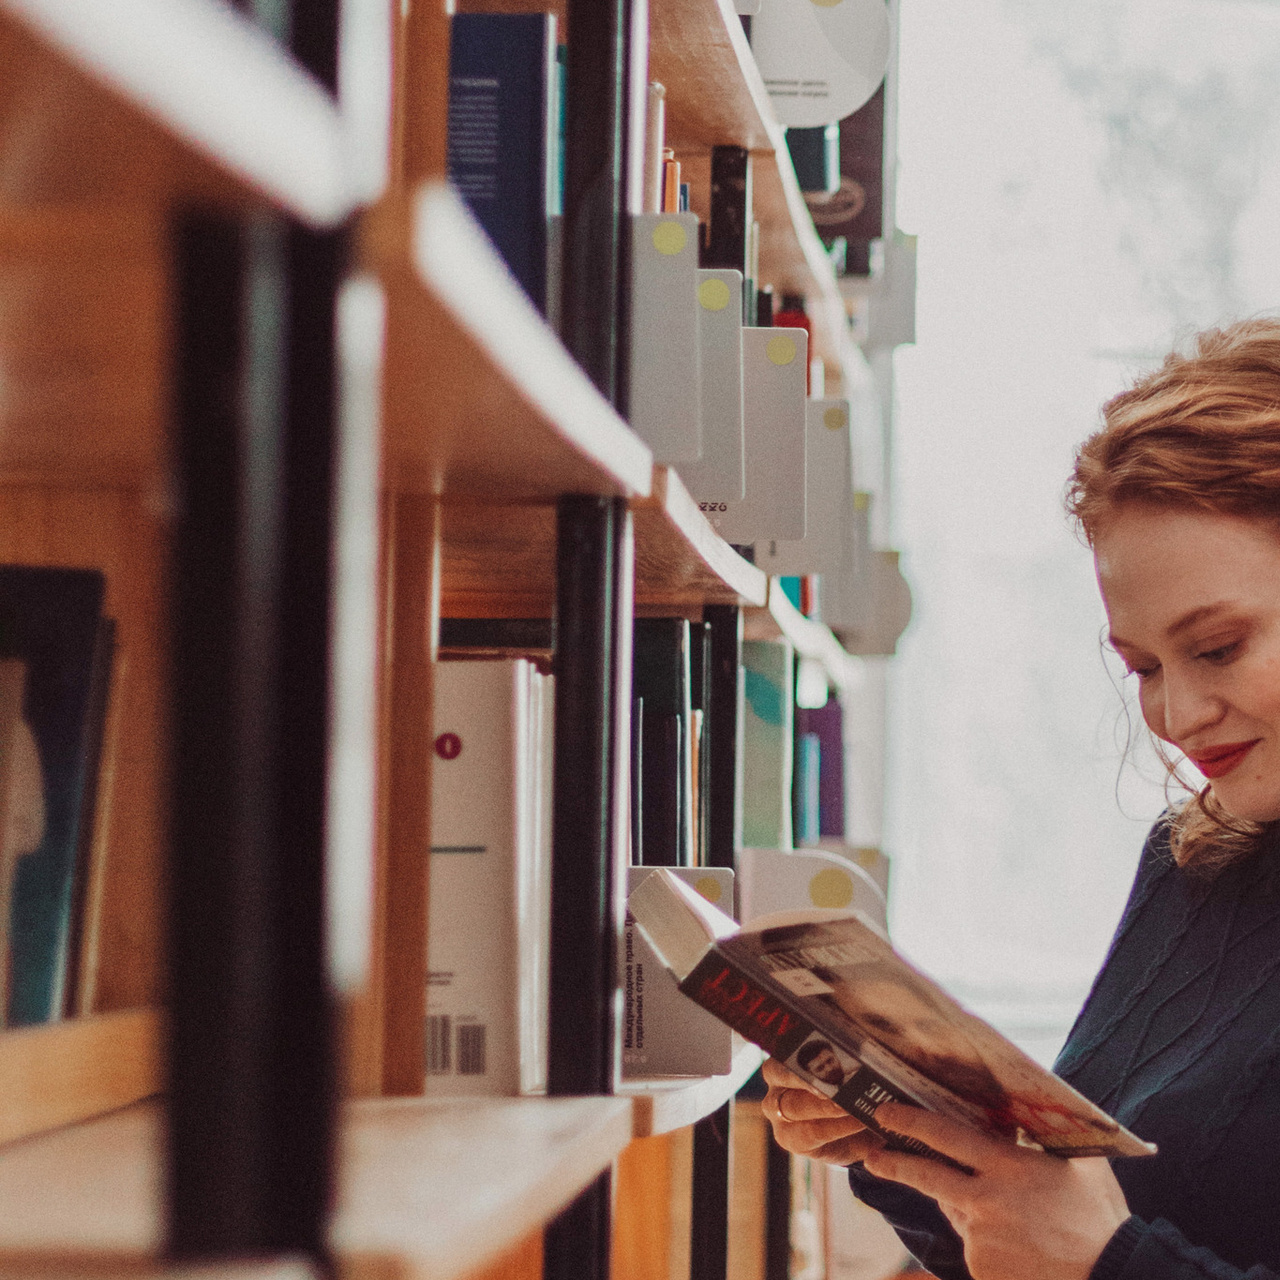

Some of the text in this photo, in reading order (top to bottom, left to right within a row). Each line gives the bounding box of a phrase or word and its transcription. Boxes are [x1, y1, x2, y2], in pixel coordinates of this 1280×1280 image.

[625, 964, 635, 1048] Международное
[636, 963, 644, 1048] отдельных стран
